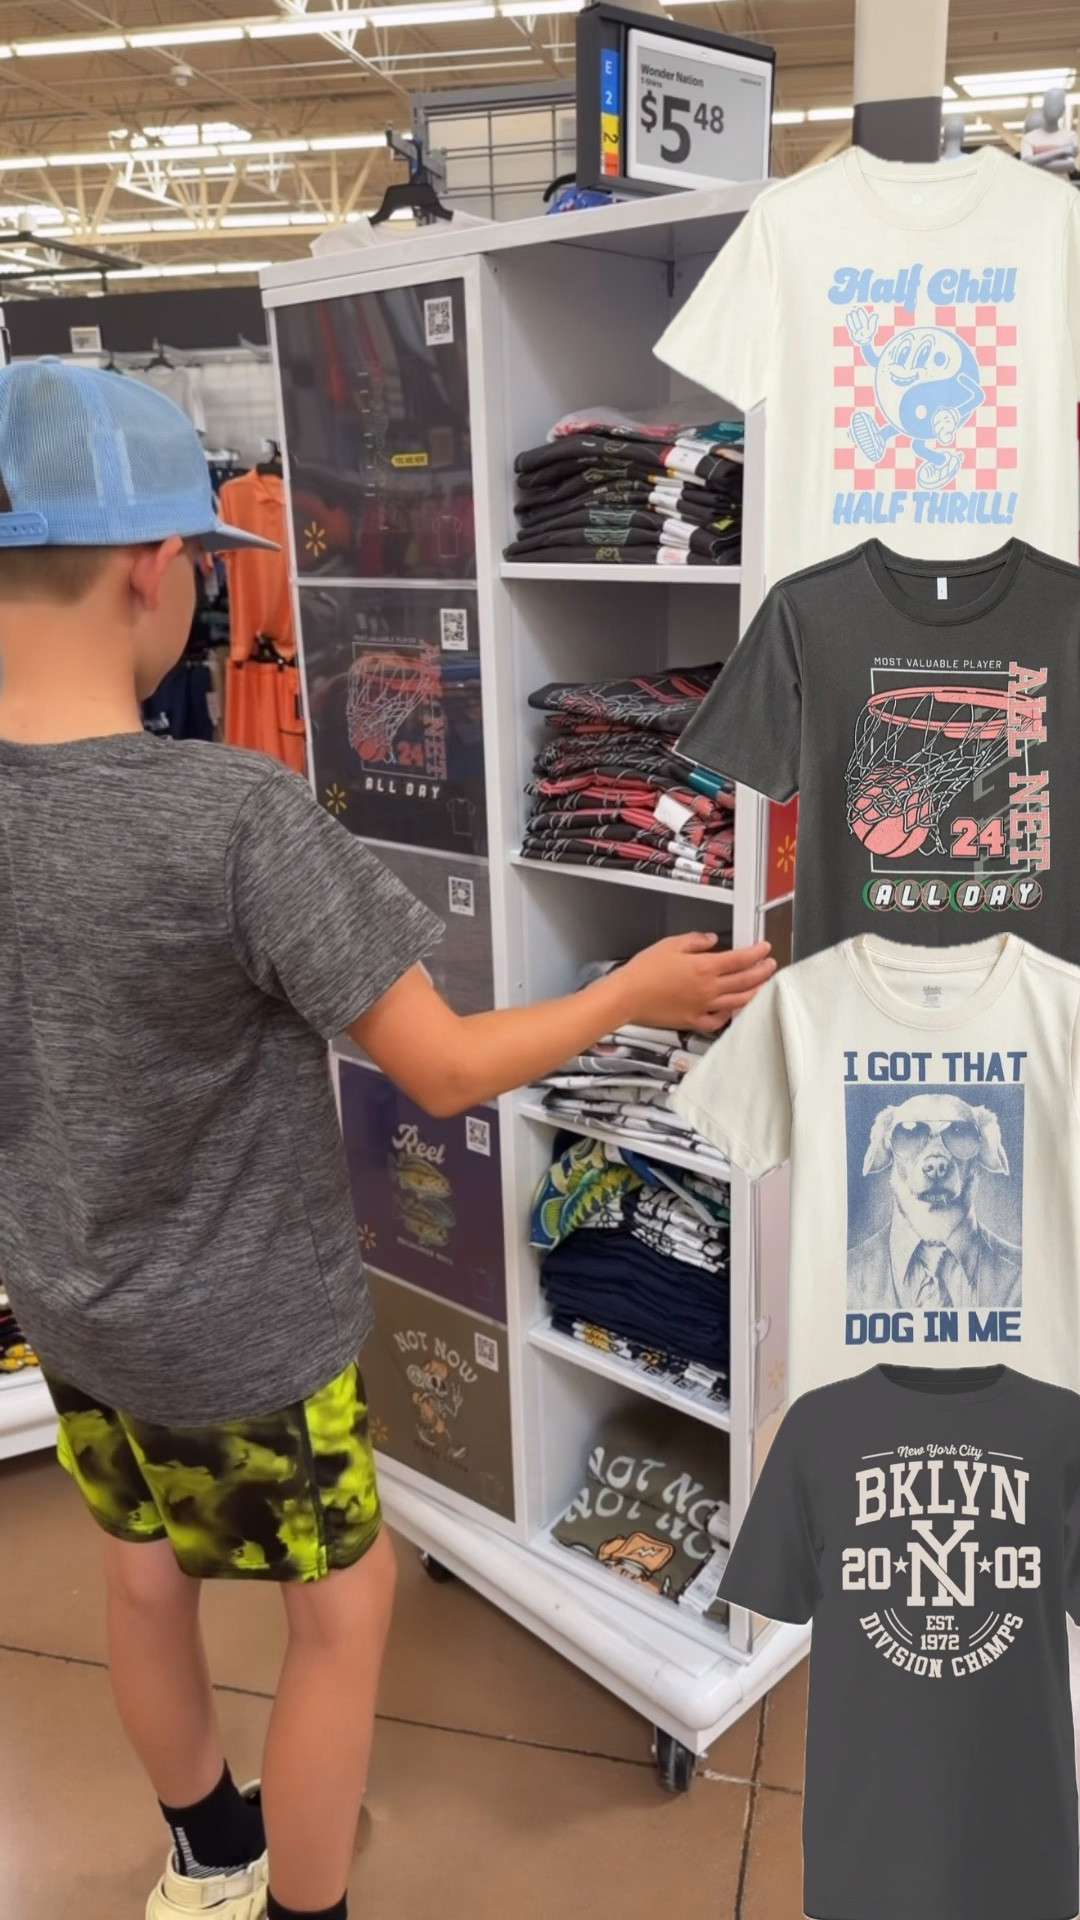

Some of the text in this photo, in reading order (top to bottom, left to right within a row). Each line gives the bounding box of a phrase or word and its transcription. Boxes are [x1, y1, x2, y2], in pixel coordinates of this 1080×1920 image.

[605, 60, 613, 75] E
[641, 63, 704, 88] Wonder Nation
[605, 91, 613, 105] 2
[827, 263, 1018, 312] Half Chill
[832, 491, 1018, 525] HALF THRILL!
[873, 657, 1002, 670] MOST VALUABLE PLAYER
[1007, 661, 1050, 870] ALL NET
[365, 777, 441, 799] ALL DAY
[950, 817, 1006, 859] 24
[874, 882, 1035, 907] ALL DAY
[844, 1051, 1027, 1082] I GOT THAT
[392, 1123, 446, 1165] Reel
[845, 1311, 1021, 1345] DOG IN ME
[393, 1330, 479, 1384] NOT NOW
[897, 1444, 983, 1461] New York City
[662, 1472, 716, 1531] NO
[855, 1460, 1030, 1526] BKLYN
[842, 1547, 891, 1590] 20
[995, 1546, 1041, 1589] 03
[926, 1615, 959, 1631] EST.
[859, 1612, 1024, 1678] DIVISION CHAMPS
[920, 1634, 960, 1650] 1972
